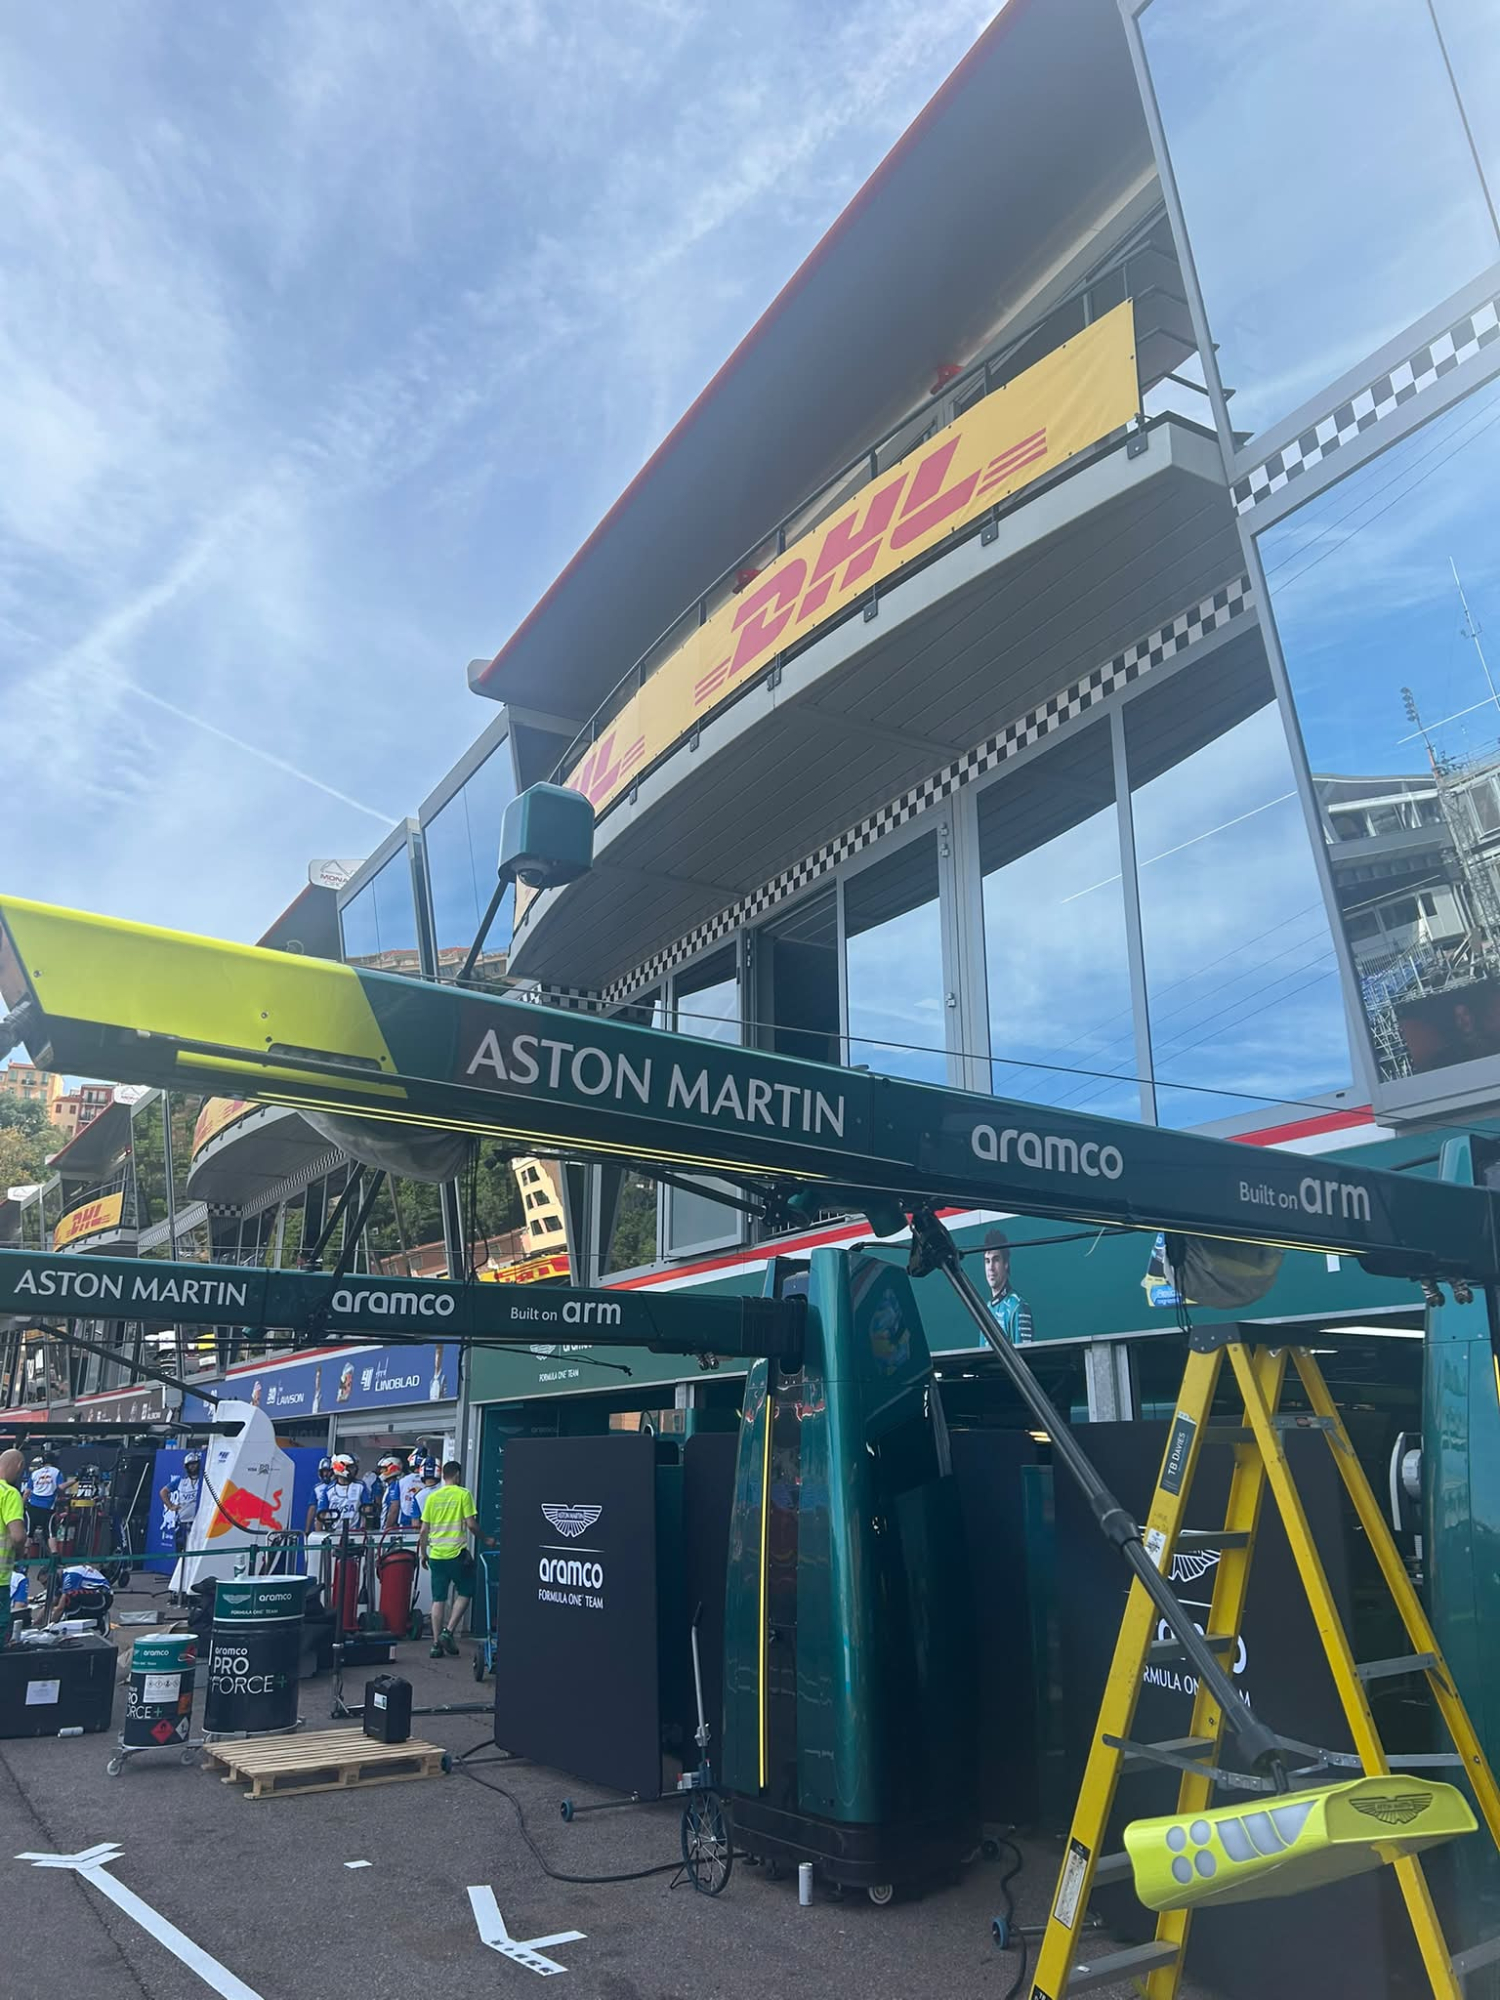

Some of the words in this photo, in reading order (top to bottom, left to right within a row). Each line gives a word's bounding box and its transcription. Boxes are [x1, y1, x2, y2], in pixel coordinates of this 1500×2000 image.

[727, 433, 983, 677] DHL
[568, 730, 622, 806] HL
[320, 873, 348, 883] MONA
[466, 1029, 652, 1104] ASTON
[667, 1064, 845, 1138] MARTIN
[971, 1124, 1124, 1180] aramco
[1239, 1181, 1276, 1206] Built
[1278, 1192, 1298, 1211] on
[1300, 1177, 1372, 1222] arm
[70, 1203, 105, 1235] DHL
[14, 1269, 123, 1299] ASTON
[131, 1276, 247, 1307] MARTIN
[331, 1289, 455, 1316] aramco
[510, 1306, 540, 1321] Built
[542, 1310, 558, 1321] on
[562, 1301, 621, 1325] arm
[375, 1375, 420, 1392] LINDBLAD
[538, 1371, 558, 1383] FORMULA
[568, 1368, 579, 1378] TEAM
[276, 1393, 305, 1406] LAWSON
[1167, 1463, 1179, 1476] TB
[539, 1558, 603, 1589] aramco
[258, 1593, 292, 1602] aramco
[538, 1588, 567, 1604] FORMULA
[585, 1595, 604, 1609] TEAM
[143, 1649, 169, 1657] aramco
[214, 1646, 248, 1656] aramco
[212, 1656, 249, 1675] PRO
[1143, 1665, 1182, 1692] RMULA
